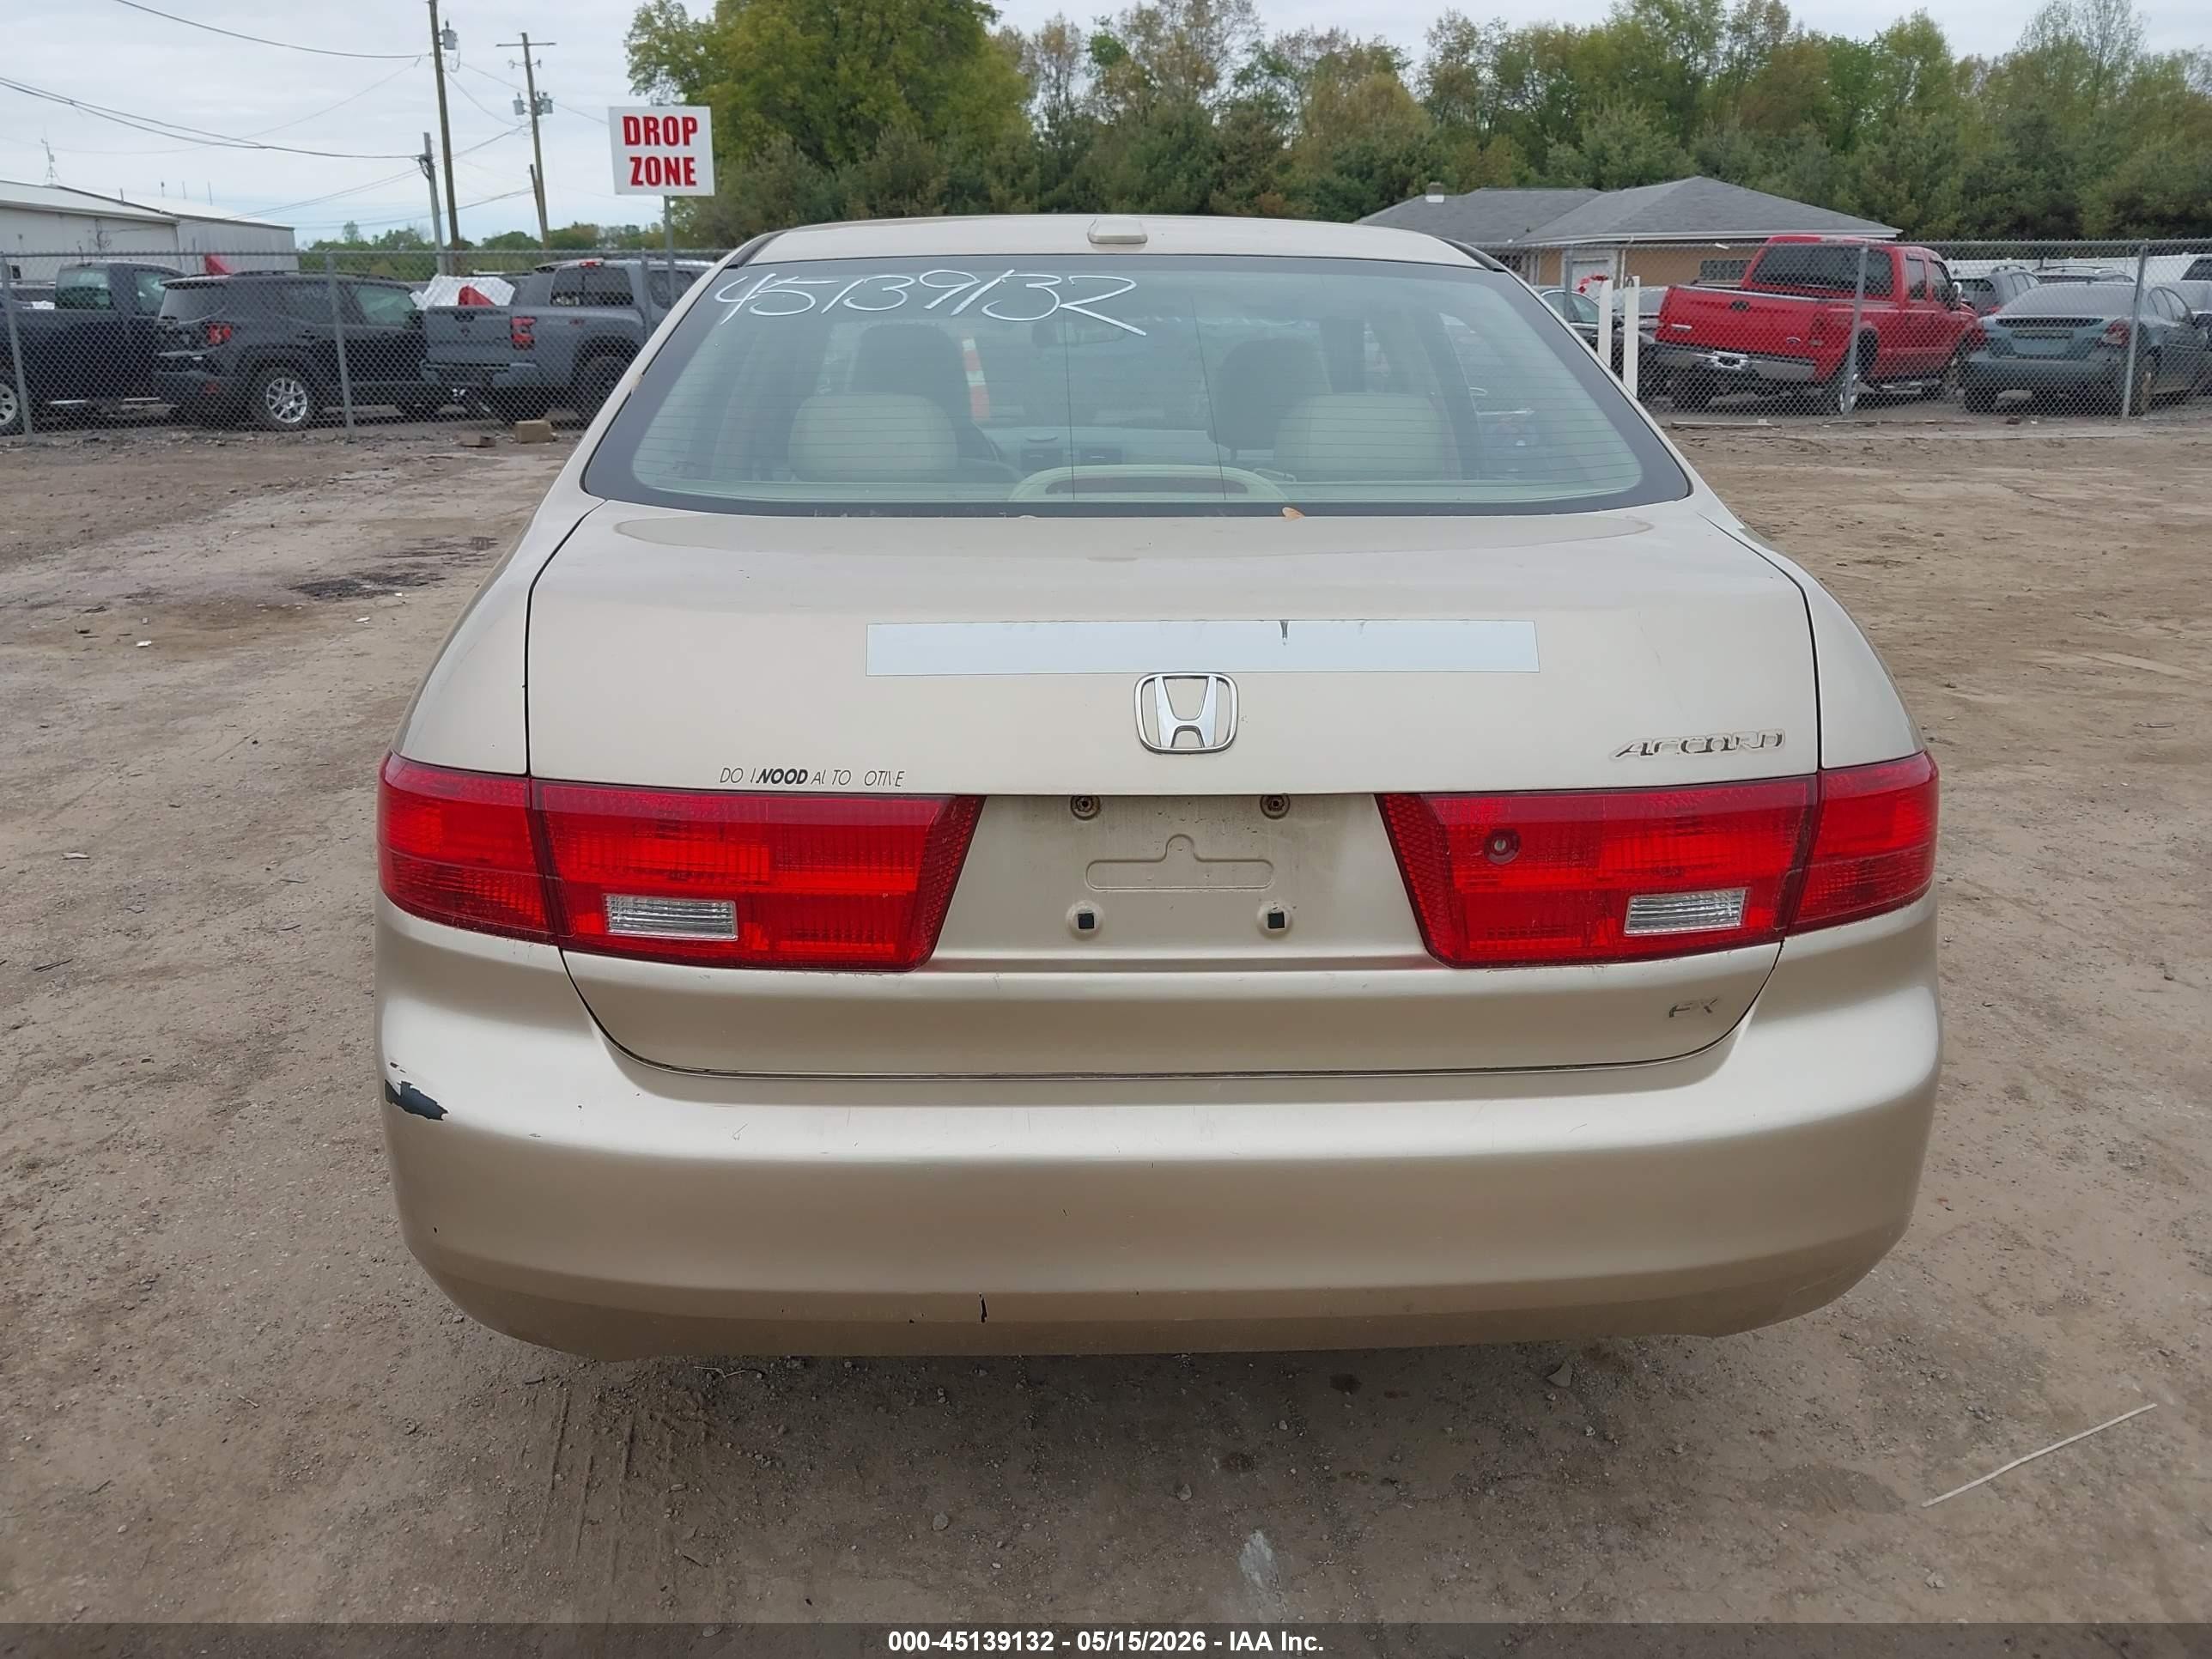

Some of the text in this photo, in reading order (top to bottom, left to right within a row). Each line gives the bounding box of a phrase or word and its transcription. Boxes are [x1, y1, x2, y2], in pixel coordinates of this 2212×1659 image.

[623, 115, 698, 147] DROP
[629, 156, 697, 187] ZONE
[714, 269, 1147, 337] 45139132
